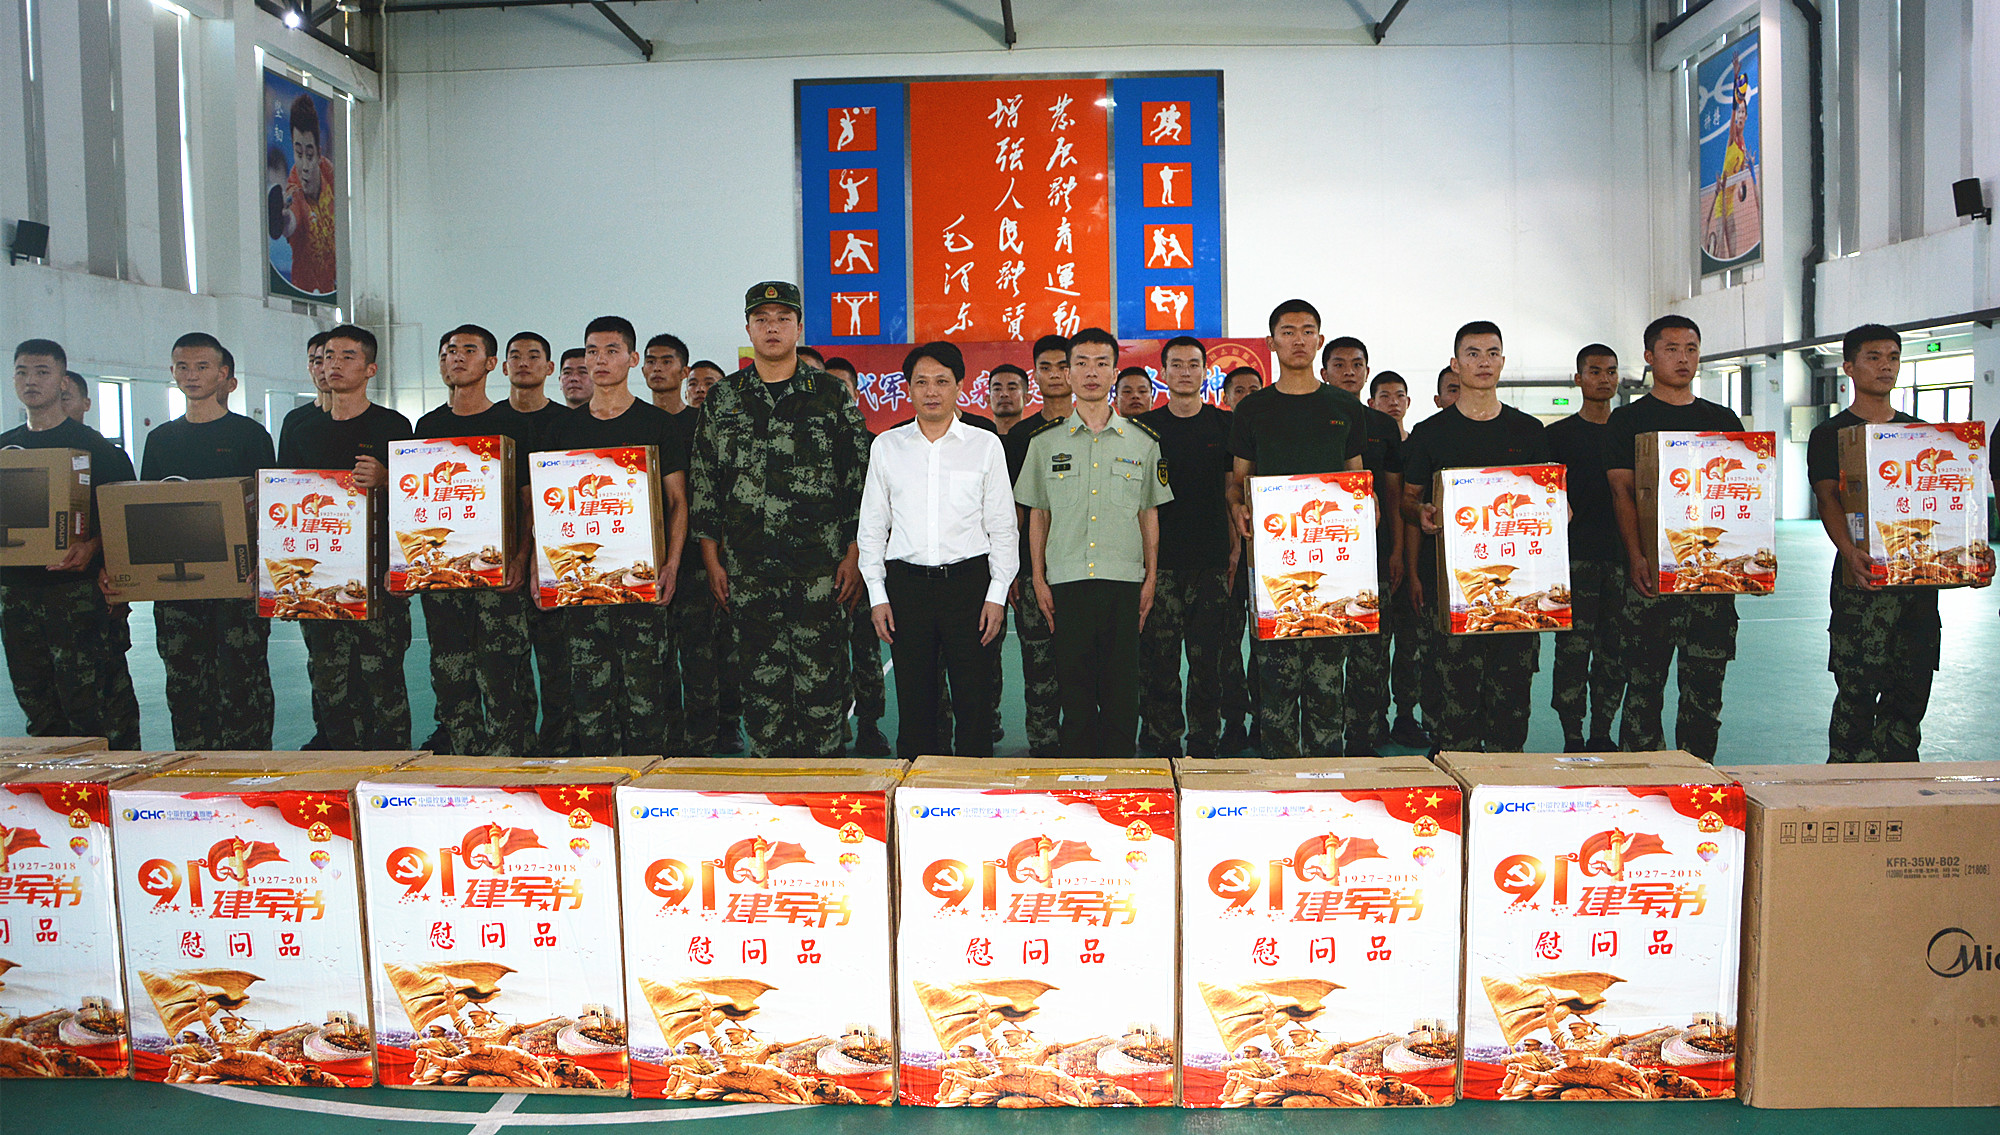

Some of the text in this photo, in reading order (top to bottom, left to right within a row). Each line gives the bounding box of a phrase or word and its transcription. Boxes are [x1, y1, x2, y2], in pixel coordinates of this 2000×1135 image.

[1703, 483, 1762, 501] 建军节
[1914, 474, 1975, 492] 建军节
[432, 484, 486, 502] 建军节
[578, 498, 634, 516] 建军节
[1685, 505, 1751, 521] 慰问品
[1896, 496, 1963, 513] 慰问品
[414, 505, 476, 523] 慰问品
[57, 514, 66, 547] Lenovo
[300, 518, 352, 535] 建军节
[561, 519, 625, 538] 慰问品
[1300, 524, 1360, 543] 建军节
[1492, 518, 1553, 537] 建军节
[283, 537, 342, 552] 慰问品
[1474, 540, 1542, 559] 慰问品
[238, 547, 247, 583] Lenovo
[1282, 547, 1350, 566] 慰问品
[114, 574, 131, 582] LED
[389, 796, 417, 807] CHG
[1505, 801, 1536, 813] CHG
[139, 809, 166, 820] CHG
[650, 807, 679, 817] CHG
[930, 807, 961, 817] CHG
[1217, 806, 1248, 816] CHG
[12, 862, 76, 870] 1927-2018
[508, 863, 577, 872] 1927-2018
[1628, 869, 1702, 879] 1927-2018
[252, 875, 318, 884] 1927-2018
[773, 879, 845, 888] 1927-2018
[1057, 877, 1131, 886] 1927-2018
[1344, 874, 1418, 883] 1927-2018
[464, 876, 584, 911] 建军节
[1575, 882, 1708, 918] 建军节
[212, 888, 326, 922] 建军节
[724, 891, 852, 928] 建军节
[1005, 890, 1137, 927] 建军节
[1292, 887, 1424, 923] 建军节
[429, 921, 557, 949] 慰问品
[180, 931, 301, 959] 慰问品
[688, 936, 821, 965] 慰问品
[966, 937, 1105, 966] 慰问品
[1252, 935, 1391, 966] 慰问品
[1535, 929, 1673, 960] 慰问品
